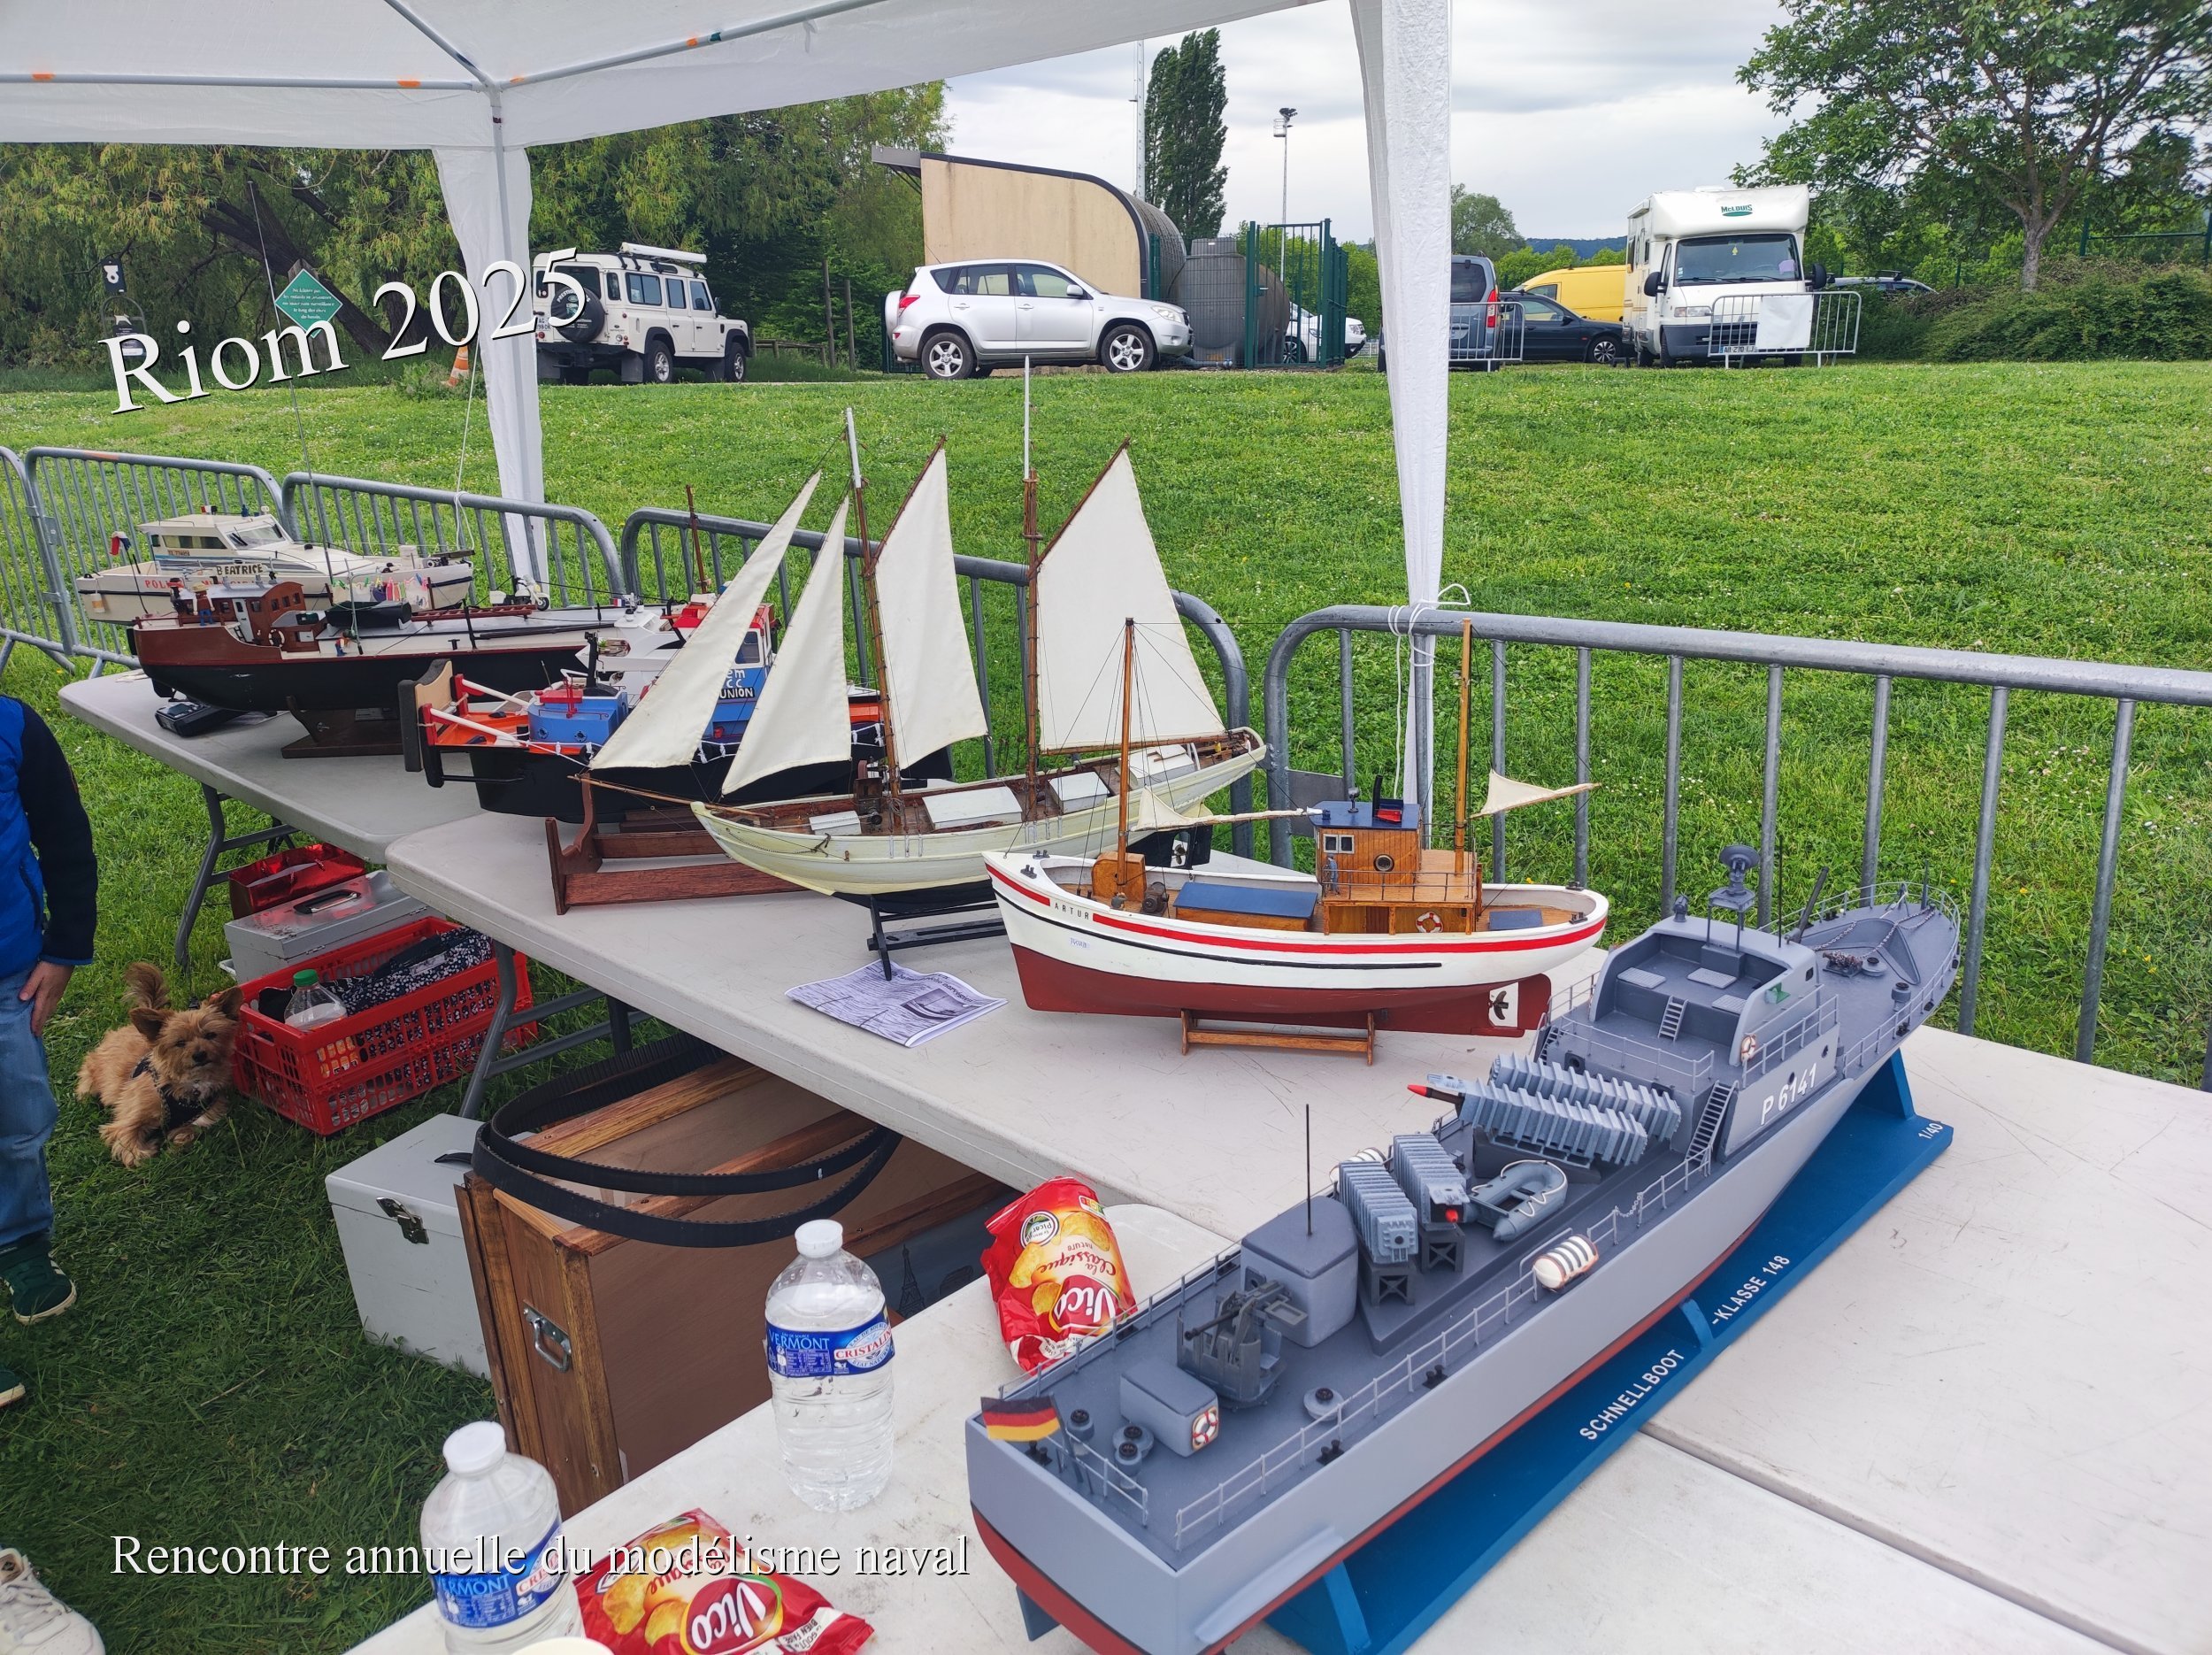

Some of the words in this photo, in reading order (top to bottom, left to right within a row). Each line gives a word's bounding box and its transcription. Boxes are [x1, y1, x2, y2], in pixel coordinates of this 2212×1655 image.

[217, 564, 263, 575] BEATRICE
[1055, 903, 1089, 920] ARTUR
[1761, 1095, 1774, 1126] P
[1778, 1062, 1816, 1112] 6141
[1917, 1123, 1944, 1139] 1/40
[1067, 1242, 1094, 1252] nature
[1037, 1251, 1117, 1277] Classique
[769, 1329, 830, 1350] VERMONT
[1579, 1349, 1685, 1440] SCHNELLBOOT
[1763, 1255, 1790, 1275] 148
[692, 1582, 767, 1649] Vico
